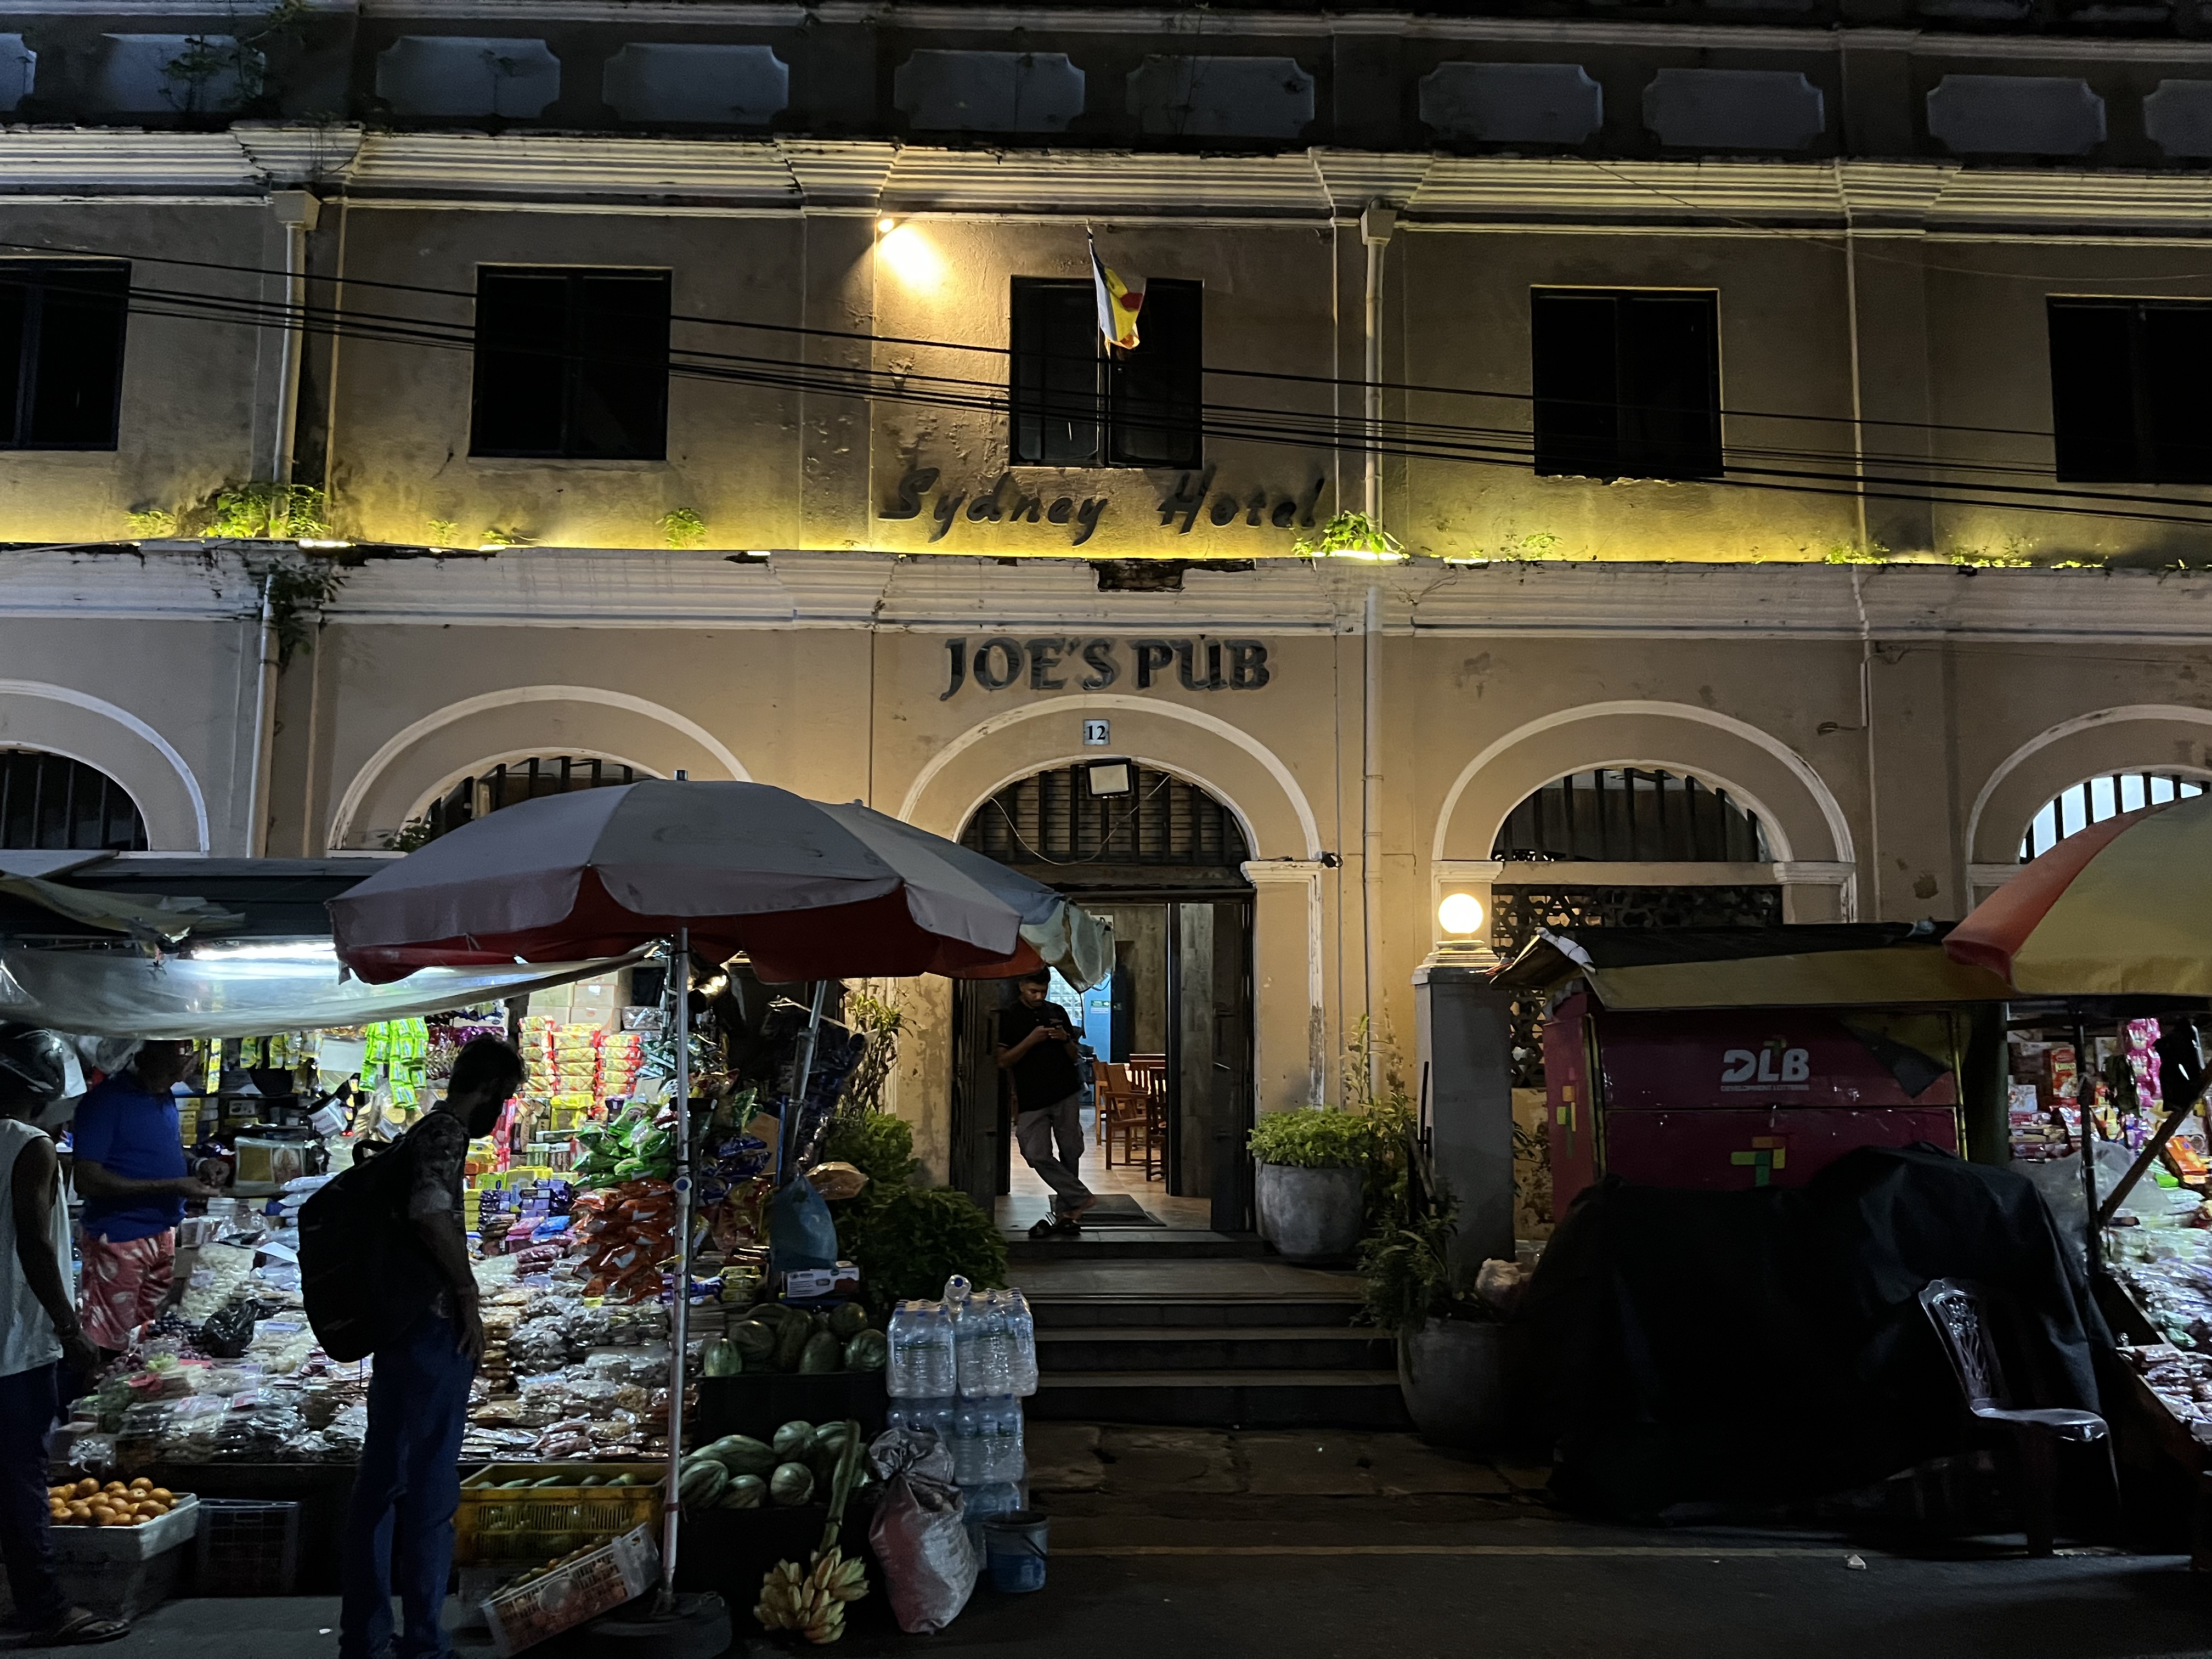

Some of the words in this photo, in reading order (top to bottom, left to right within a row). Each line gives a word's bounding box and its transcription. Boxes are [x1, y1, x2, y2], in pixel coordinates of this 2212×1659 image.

[878, 466, 1108, 546] Sydney
[1156, 465, 1325, 535] Hotel
[939, 637, 1116, 701] JOE'S
[1131, 638, 1270, 691] PUB
[1086, 725, 1107, 740] 12
[1721, 1048, 1810, 1082] DLB
